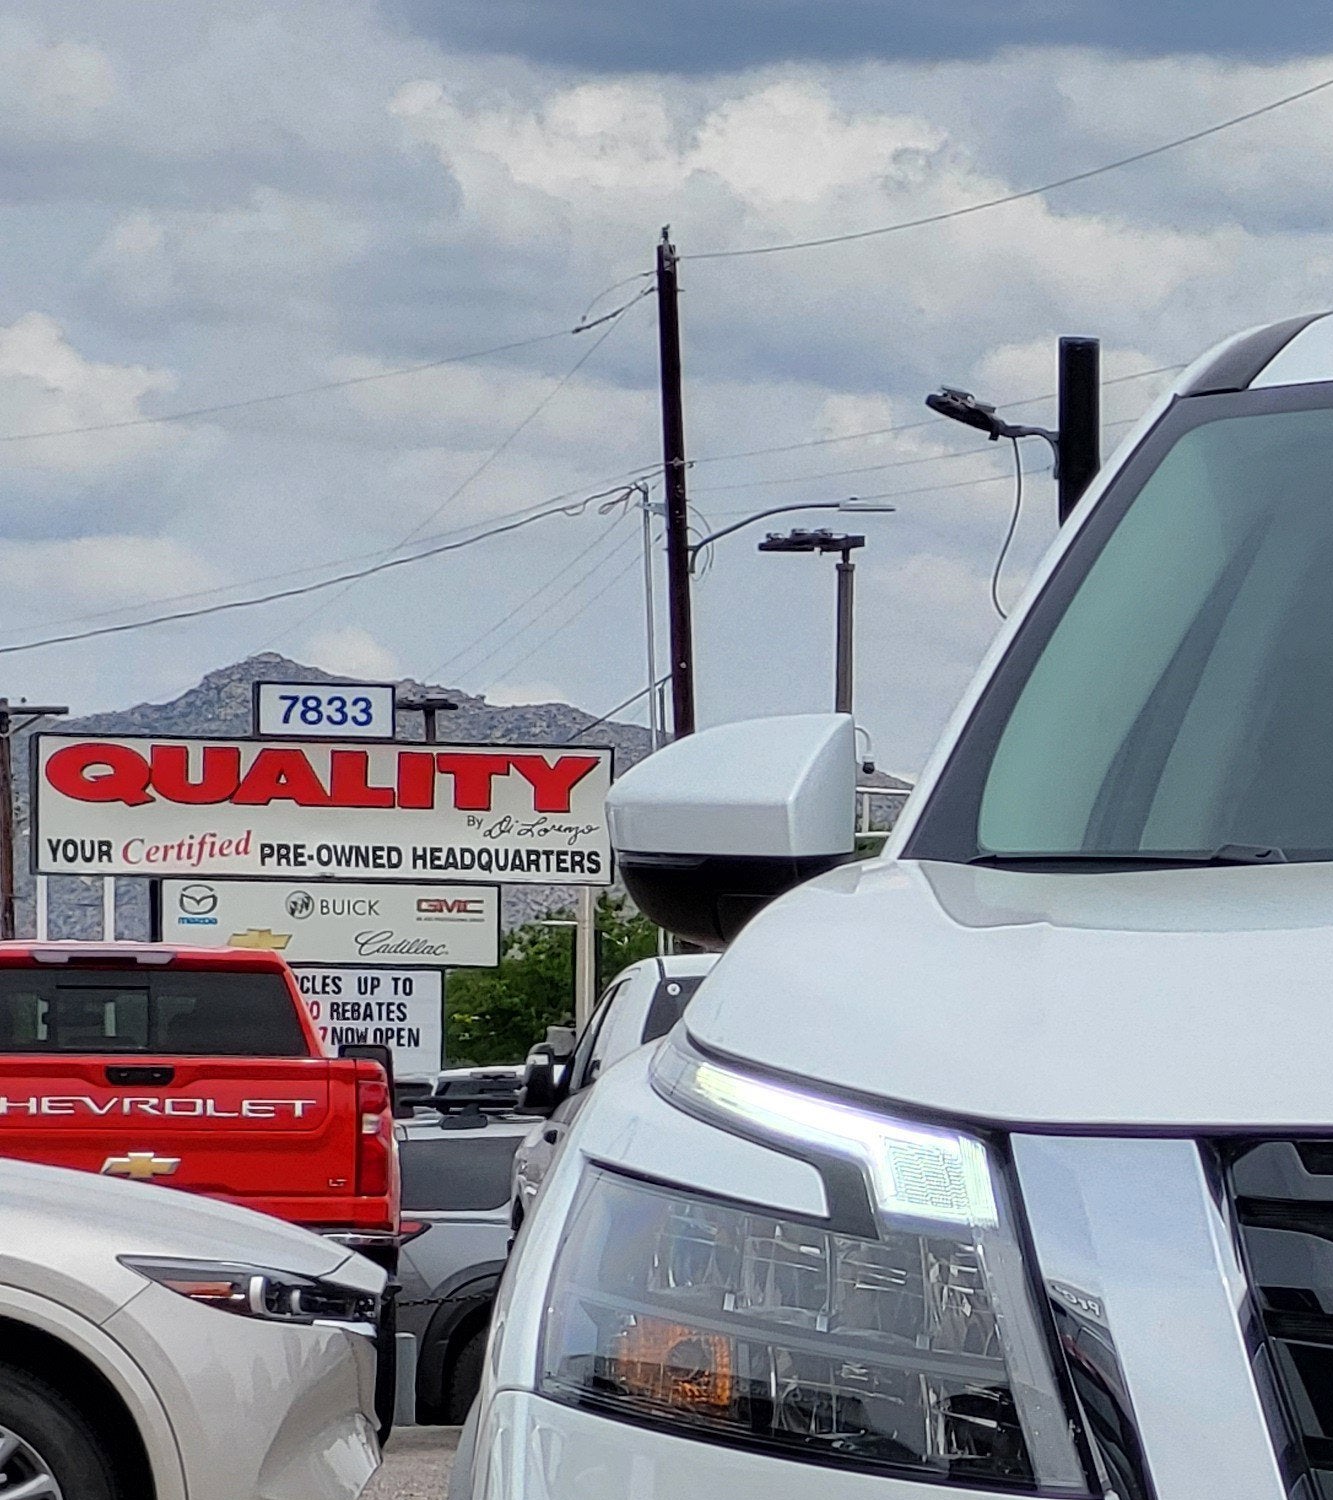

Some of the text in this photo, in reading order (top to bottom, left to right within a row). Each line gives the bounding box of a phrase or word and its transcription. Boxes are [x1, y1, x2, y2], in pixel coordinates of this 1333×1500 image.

[278, 694, 373, 726] 7833
[45, 742, 602, 813] QUALITY
[466, 815, 483, 829] By
[47, 829, 601, 874] YOUR Certified PRE-OWNED HEADQUARTERS
[320, 898, 380, 916] BUICK
[416, 899, 484, 914] GMC
[354, 930, 449, 956] Cadillac
[357, 976, 380, 996] UP
[392, 976, 413, 996] TO
[330, 1001, 408, 1022] REBATES
[330, 1026, 369, 1046] NOW
[373, 1027, 421, 1048] OPEN
